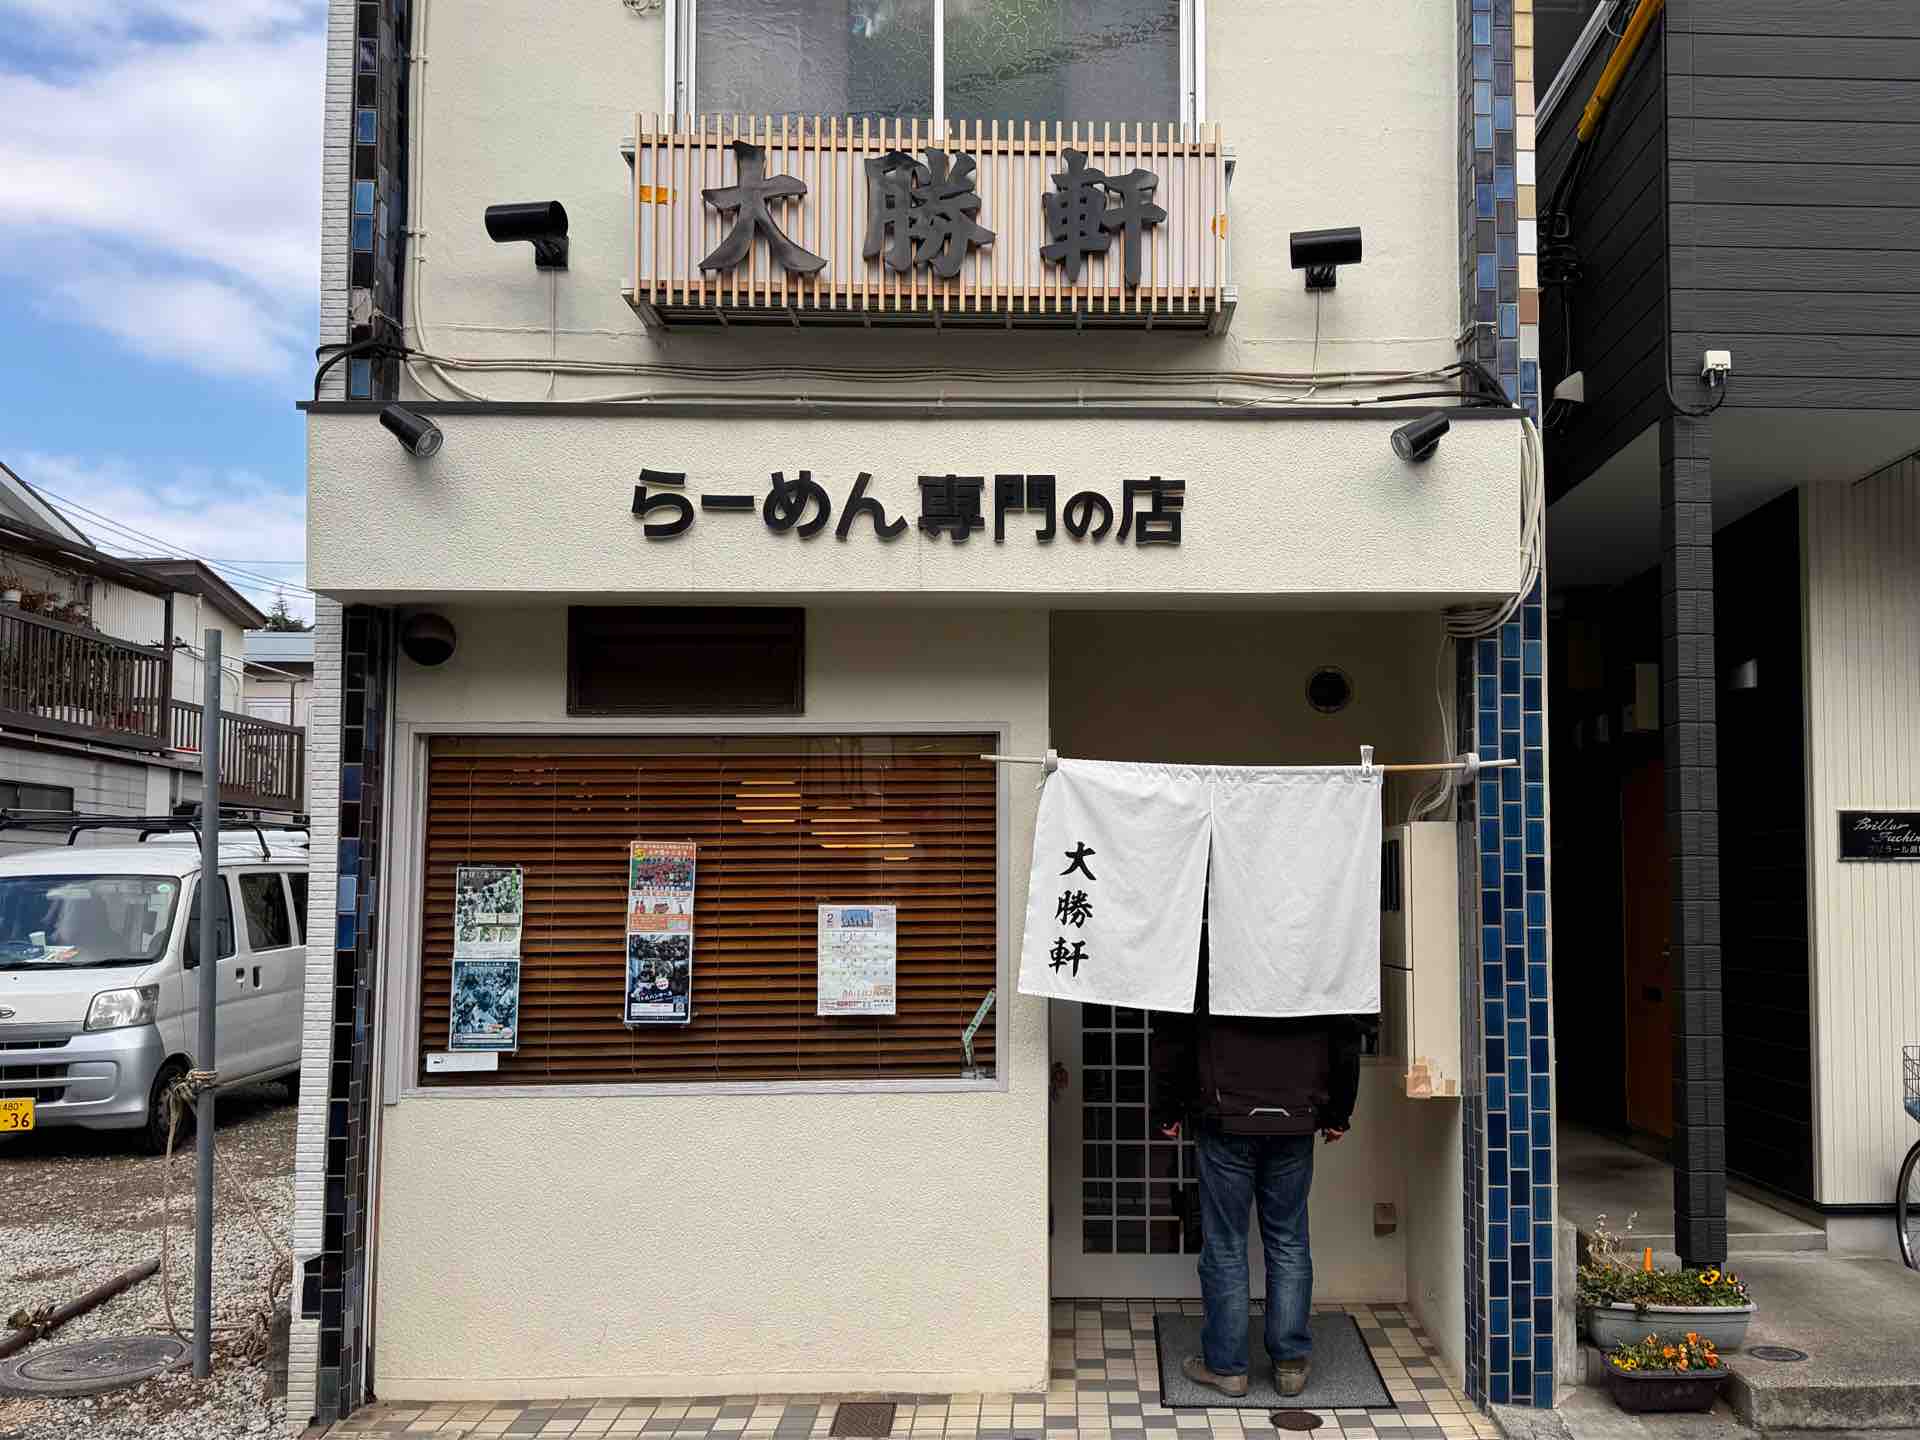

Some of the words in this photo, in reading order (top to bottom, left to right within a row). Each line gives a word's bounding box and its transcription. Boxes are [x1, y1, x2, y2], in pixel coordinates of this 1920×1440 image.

[699, 140, 1168, 287] 大勝軒
[631, 469, 1187, 546] らーめん専門の店
[1048, 841, 1097, 978] 大勝軒
